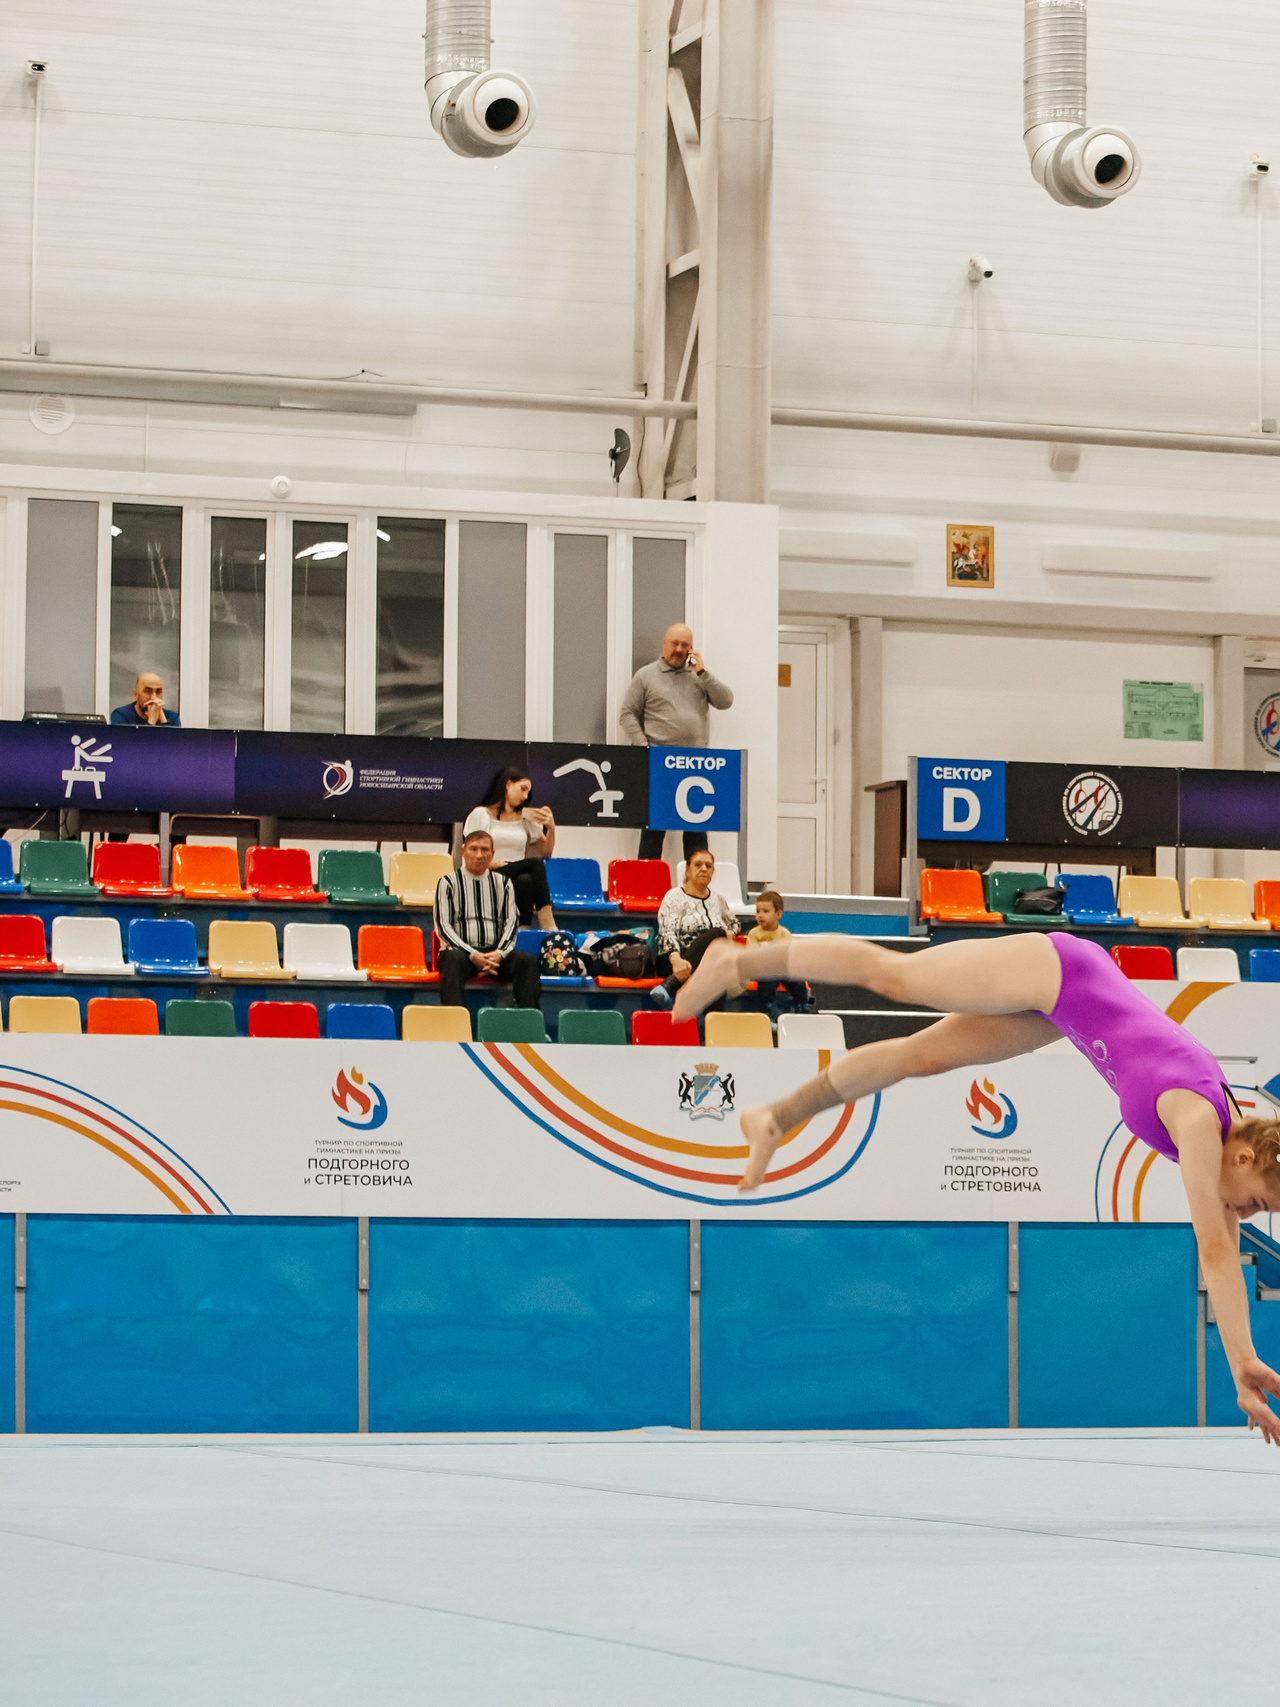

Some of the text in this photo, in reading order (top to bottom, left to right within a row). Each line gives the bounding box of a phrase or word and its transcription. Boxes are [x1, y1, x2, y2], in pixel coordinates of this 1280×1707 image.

[664, 755, 726, 770] СЕКТОР
[932, 766, 992, 781] СЕКТОР
[675, 776, 715, 823] C
[943, 787, 981, 832] D
[308, 1158, 410, 1171] ПОДГОРНОГО
[944, 1165, 1038, 1177] ПОДГОРНОГО
[315, 1174, 413, 1186] СТРЕТОВИЧА
[950, 1180, 1041, 1192] СТРЕТОВИЧА
